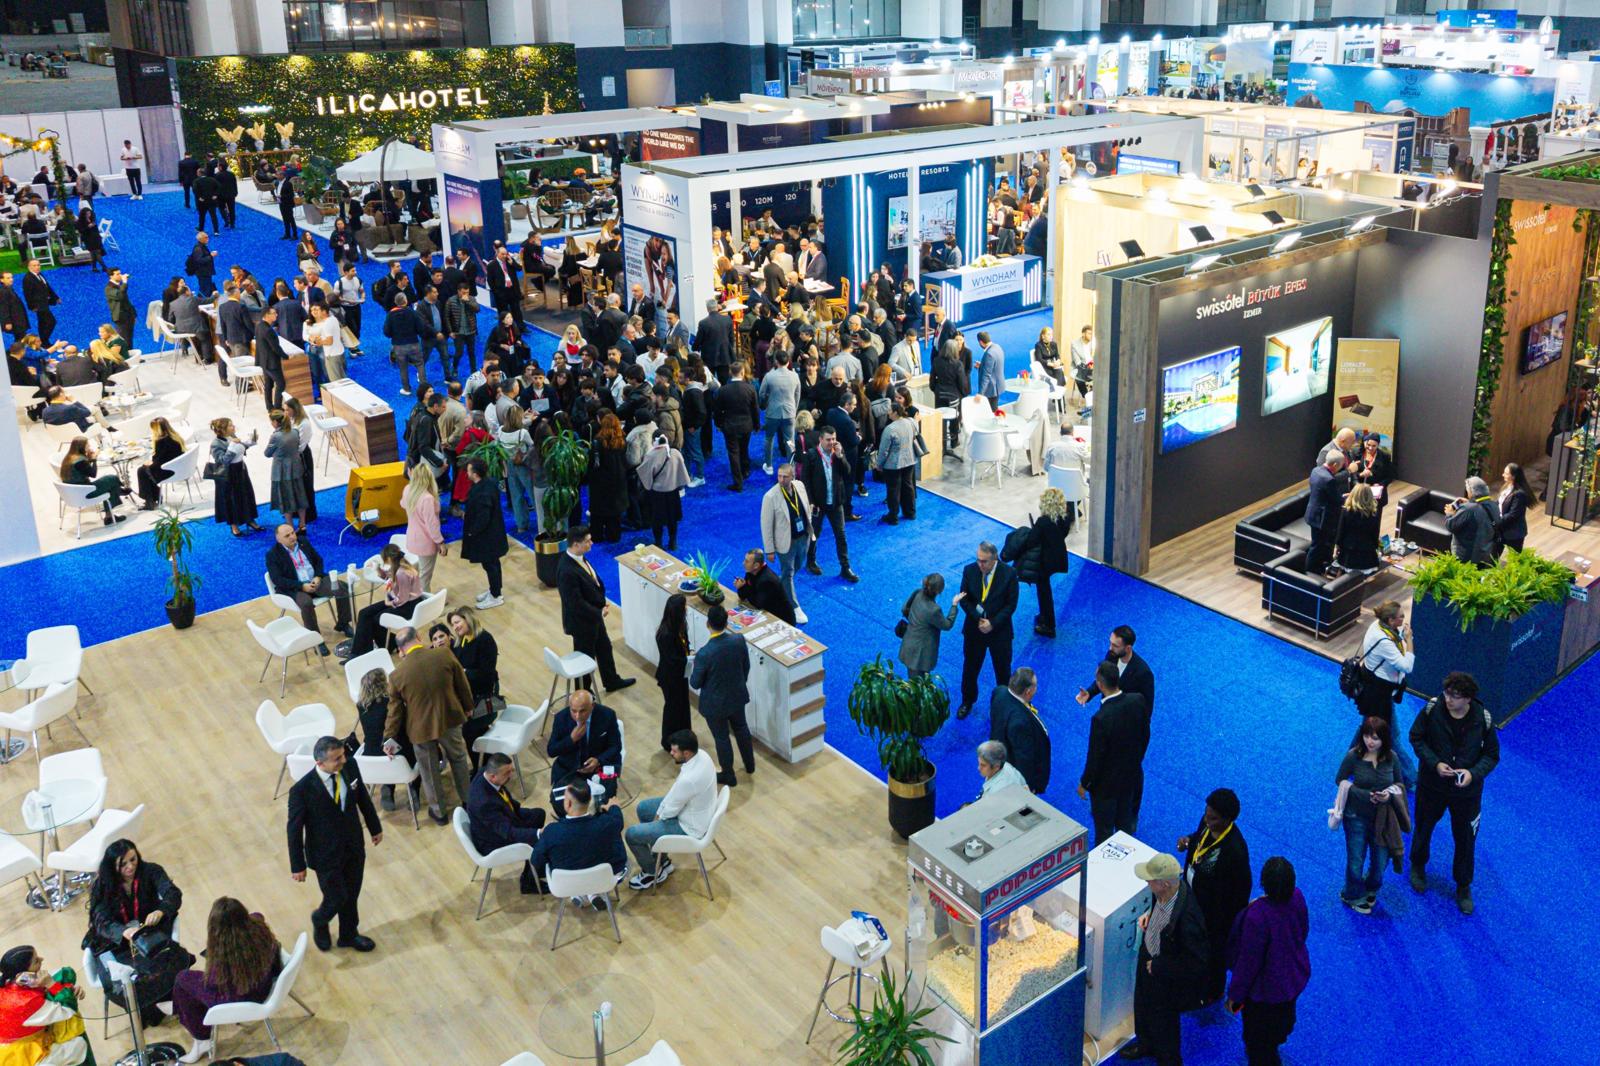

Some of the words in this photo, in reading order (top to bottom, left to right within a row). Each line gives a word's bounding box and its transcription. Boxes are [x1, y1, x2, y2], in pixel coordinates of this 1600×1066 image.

[660, 131, 684, 143] WELCOMES
[685, 135, 695, 144] THE
[643, 138, 659, 147] WORLD
[659, 140, 670, 149] LIKE
[678, 143, 686, 151] DO
[888, 171, 909, 180] HOTEL
[921, 166, 950, 176] RESORTS
[755, 196, 773, 205] 120M
[972, 270, 1017, 287] WYNDHAM
[1196, 287, 1246, 320] swissôtel
